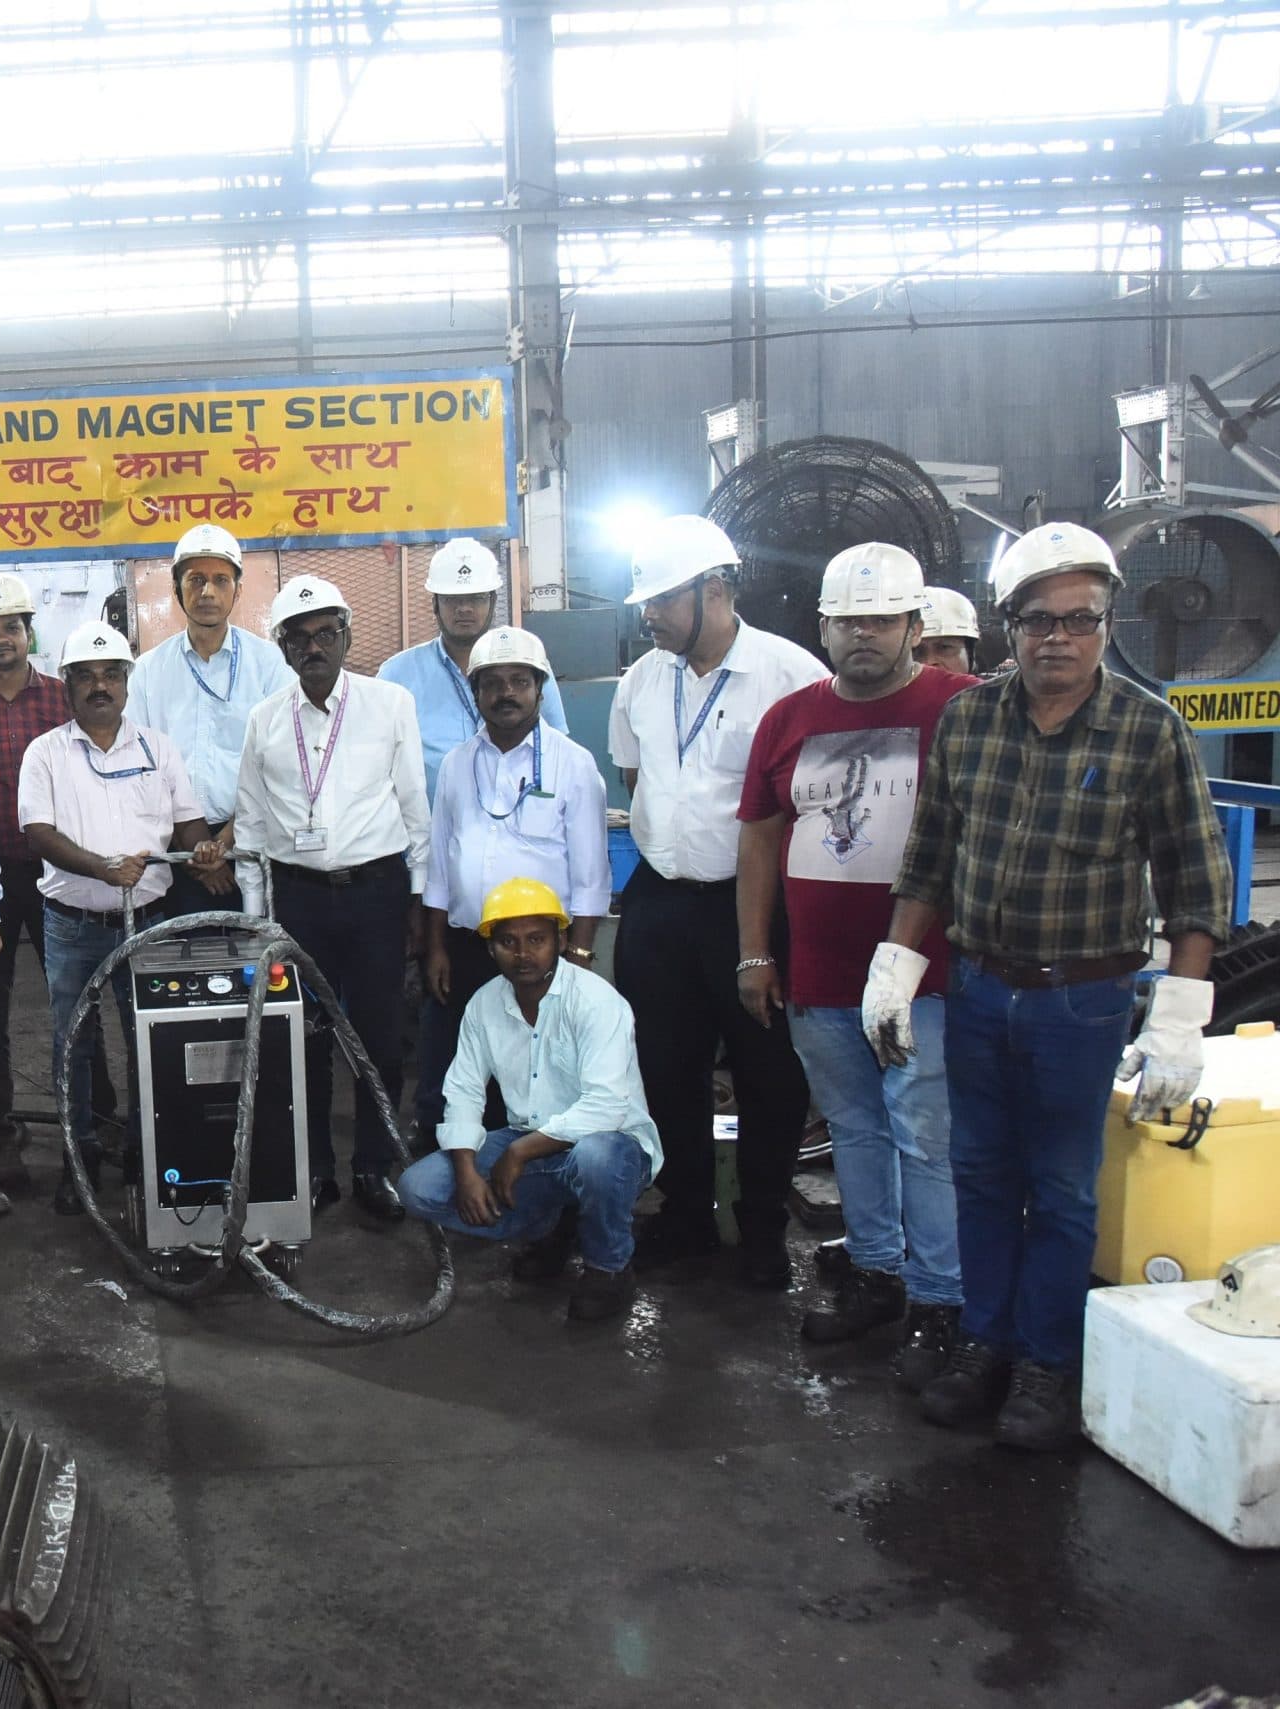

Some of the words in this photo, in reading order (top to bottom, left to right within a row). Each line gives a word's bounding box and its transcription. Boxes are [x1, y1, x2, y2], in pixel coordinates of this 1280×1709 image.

[77, 398, 265, 439] MAGNET
[285, 388, 490, 430] SECTION
[1, 456, 87, 491] बाद
[113, 450, 209, 480] काम
[233, 433, 280, 475] के
[303, 441, 411, 475] साथ
[128, 477, 253, 527] आपके
[794, 778, 913, 800] HEAVENLY
